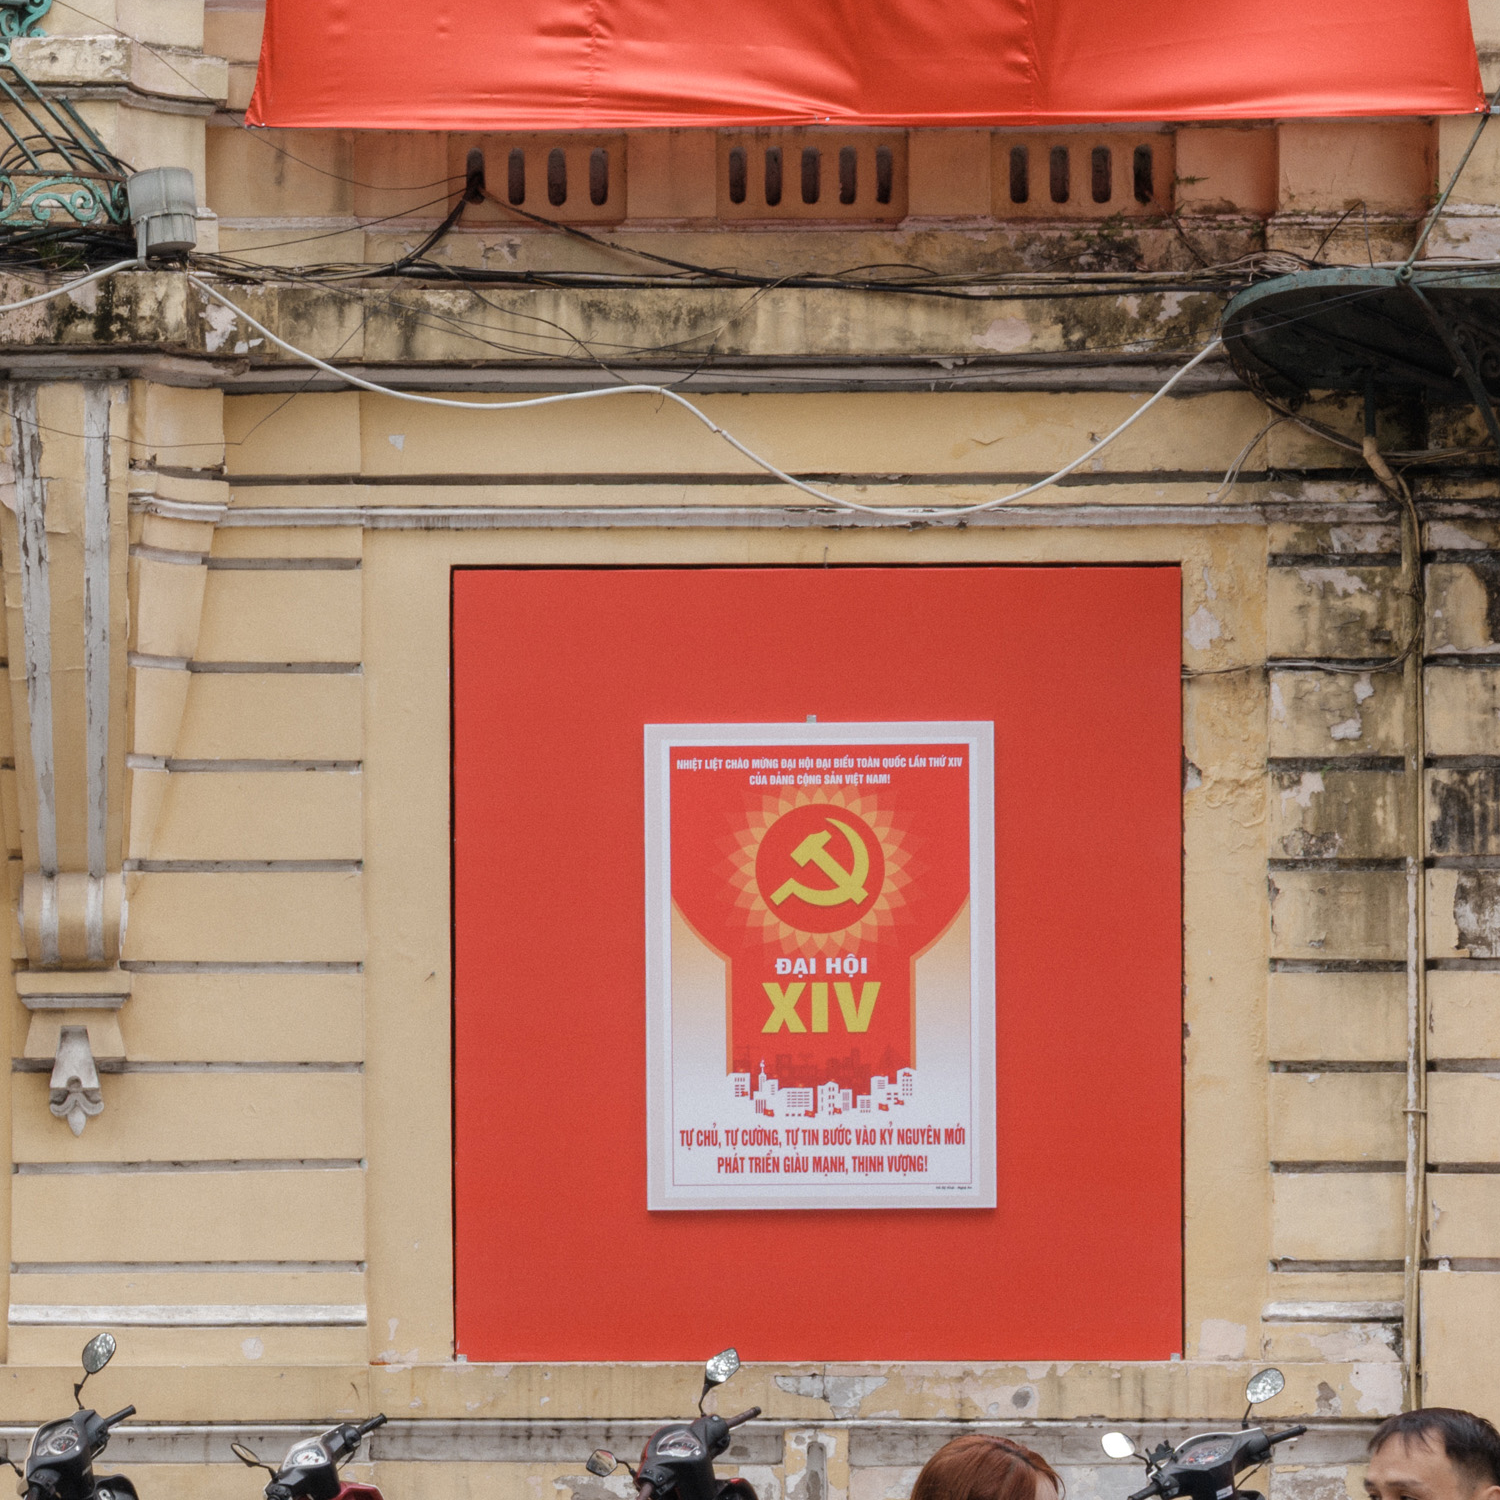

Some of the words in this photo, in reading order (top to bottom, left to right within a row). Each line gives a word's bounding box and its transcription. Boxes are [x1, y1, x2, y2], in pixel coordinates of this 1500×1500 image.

[676, 757, 703, 771] NHIỆT
[704, 757, 723, 771] LIỆT
[725, 757, 750, 770] CHÀO
[751, 756, 779, 769] MỪNG
[780, 758, 796, 771] ĐẠI
[798, 756, 814, 771] HỘI
[815, 758, 831, 771] ĐẠI
[833, 754, 854, 768] BIỂU
[856, 756, 880, 768] TOÀN
[882, 755, 907, 769] QUỐC
[908, 754, 927, 768] LẦN
[928, 754, 946, 768] THỨ
[947, 757, 963, 767] XIV
[749, 771, 768, 785] CỦA
[769, 771, 795, 785] ĐẢNG
[796, 772, 822, 787] CỘNG
[824, 771, 843, 785] SẢN
[845, 772, 864, 786] VIỆT
[866, 774, 890, 785] NAM!
[775, 957, 816, 978] ĐẠI
[825, 953, 868, 978] HỘI
[761, 982, 881, 1033] XIV
[680, 1128, 694, 1150] TỰ
[696, 1122, 721, 1149] CHỦ,
[725, 1128, 739, 1150] TỰ
[741, 1124, 782, 1148] CƯỜNG,
[785, 1127, 800, 1150] TỰ
[802, 1129, 819, 1146] TIN
[822, 1123, 852, 1146] BƯỚC
[855, 1125, 876, 1145] VÀO
[879, 1121, 894, 1145] KỶ
[897, 1124, 941, 1145] NGUYÊN
[944, 1123, 966, 1145] MỚI
[717, 1152, 745, 1173] PHÁT
[748, 1149, 780, 1173] TRIỂN
[783, 1152, 809, 1173] GIÀU
[812, 1156, 848, 1177] MẠNH,
[852, 1156, 884, 1177] THỊNH
[887, 1154, 928, 1177] VƯỢNG!
